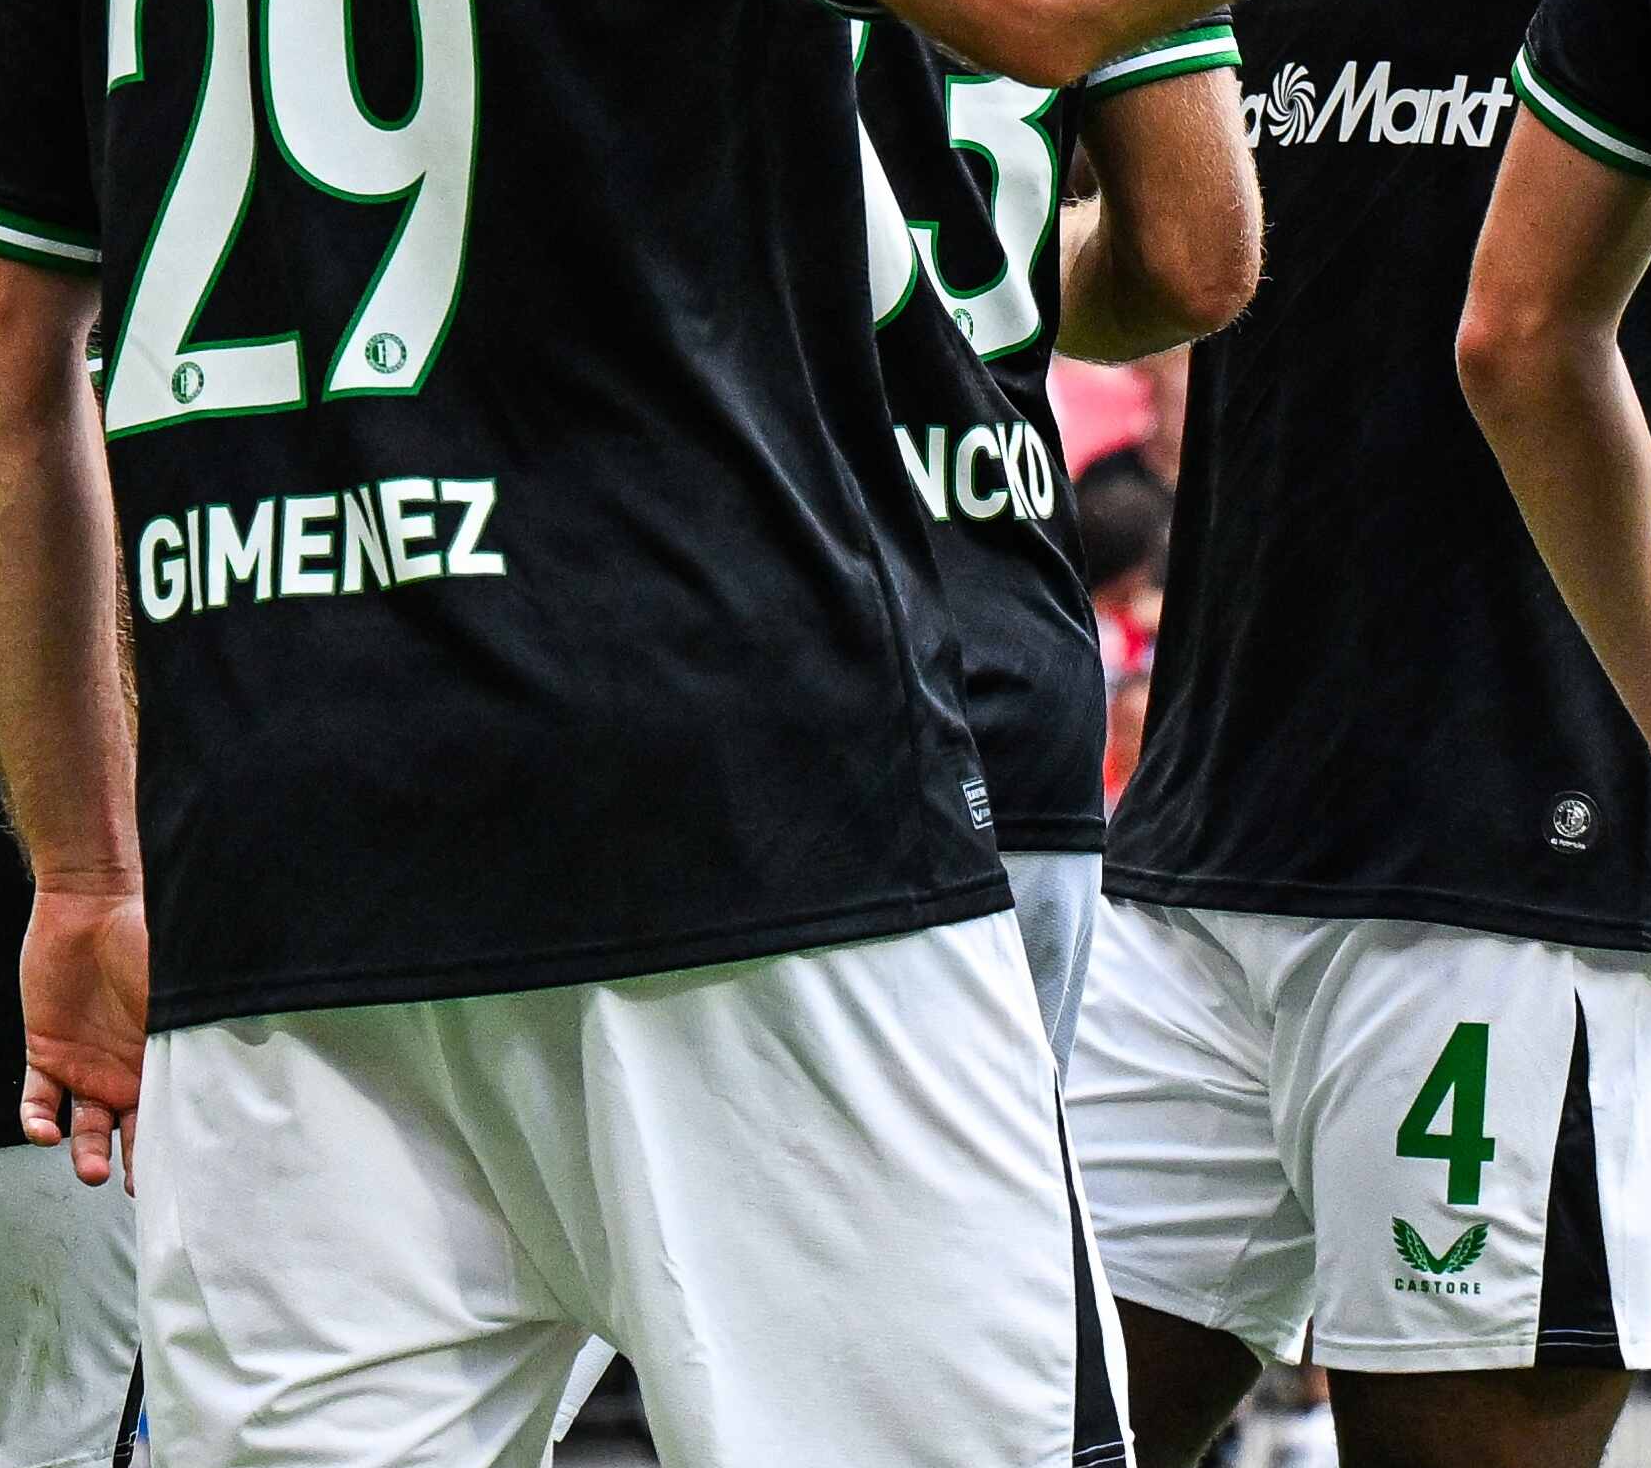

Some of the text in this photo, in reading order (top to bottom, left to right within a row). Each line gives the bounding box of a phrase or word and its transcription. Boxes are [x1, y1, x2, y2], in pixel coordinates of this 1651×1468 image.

[139, 476, 507, 621] GIMENEZ
[1396, 1022, 1496, 1206] 4
[1394, 1276, 1482, 1295] CASTORE
